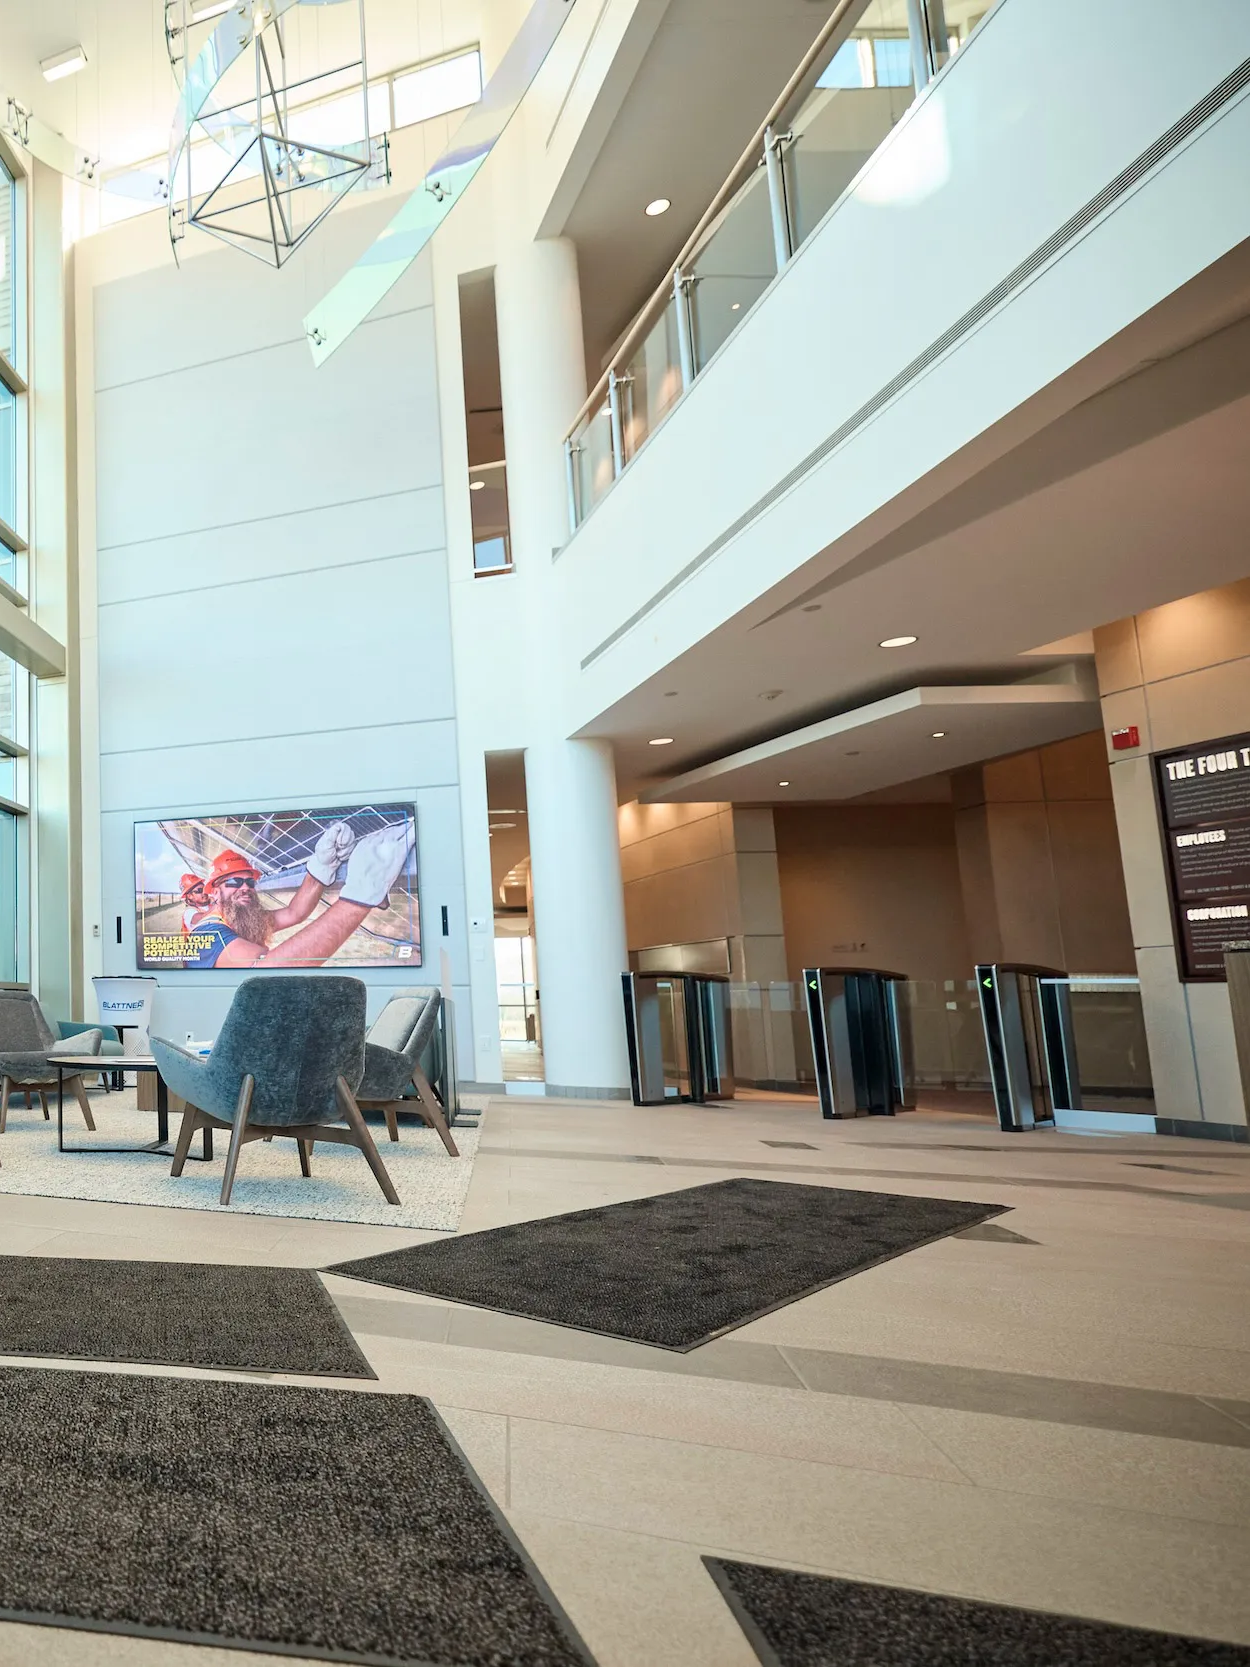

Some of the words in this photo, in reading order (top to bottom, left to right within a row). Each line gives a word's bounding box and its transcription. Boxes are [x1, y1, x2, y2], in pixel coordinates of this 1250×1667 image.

[1166, 759, 1196, 780] THE
[1197, 750, 1238, 775] FOUR
[1176, 829, 1226, 847] EMPLOYEES
[143, 936, 185, 944] REALIZE
[187, 935, 215, 943] YOUR
[143, 942, 212, 950] COMPETITIVE
[143, 949, 200, 957] POTENTIAL
[102, 1000, 144, 1009] BLATTNER
